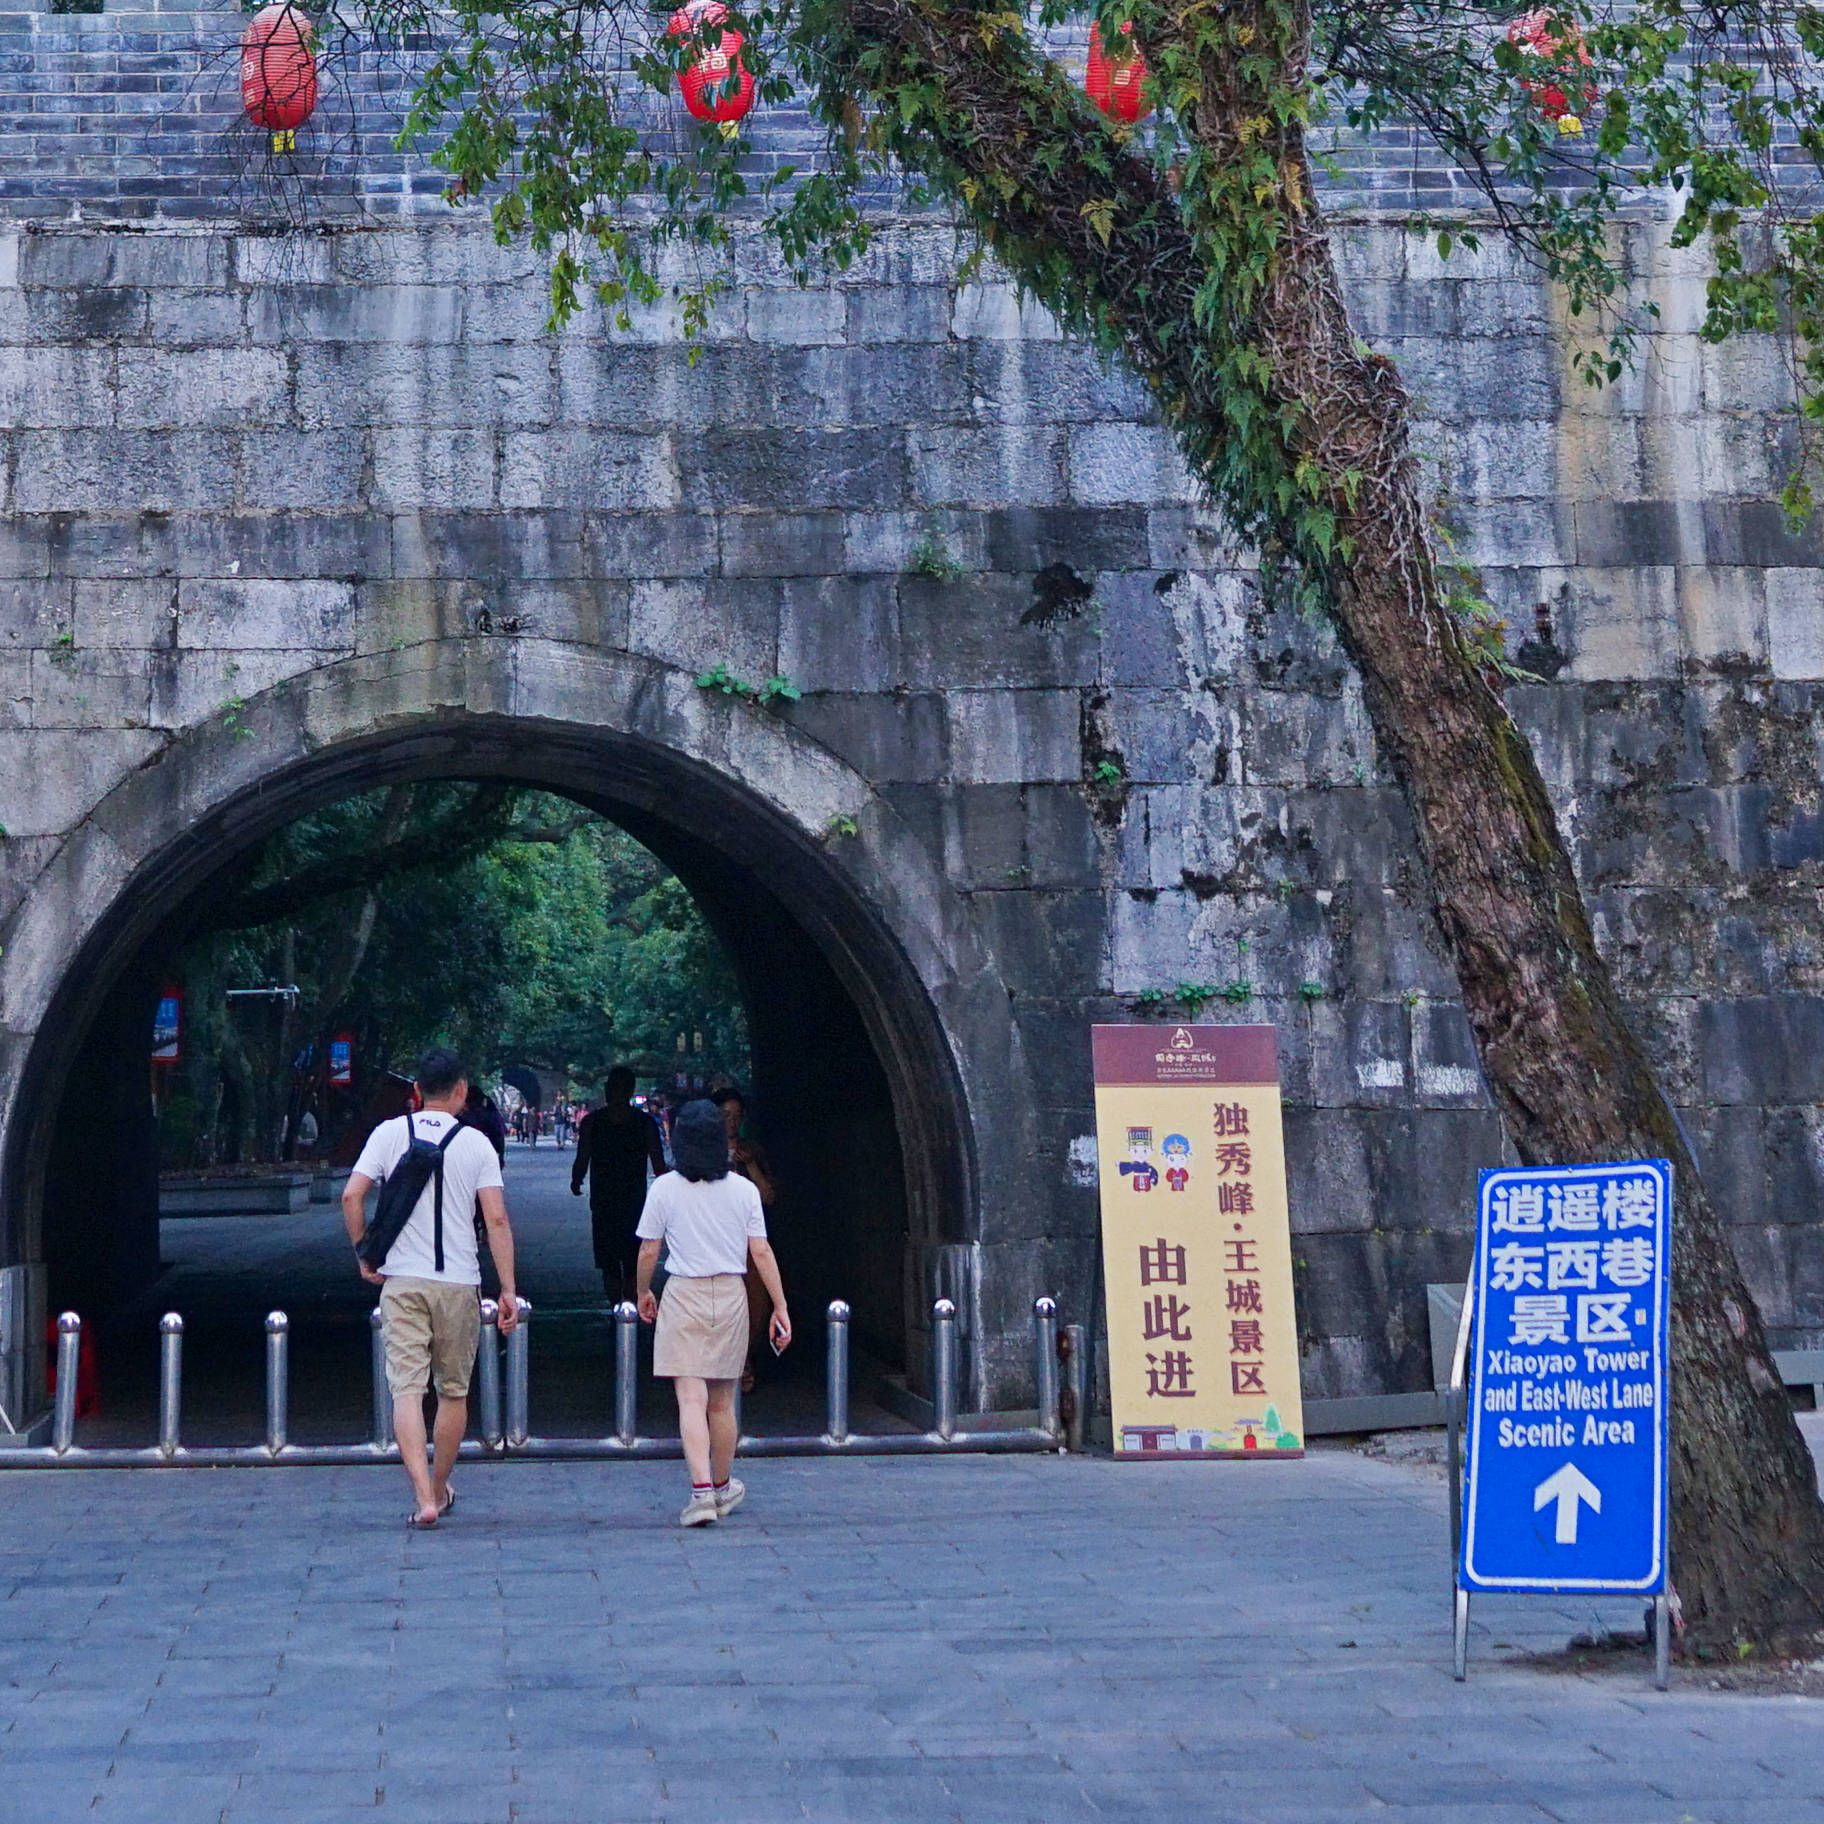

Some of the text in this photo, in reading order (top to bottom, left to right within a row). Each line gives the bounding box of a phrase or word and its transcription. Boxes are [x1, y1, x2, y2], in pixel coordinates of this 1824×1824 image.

[1491, 1178, 1656, 1234] 逍遥楼
[1212, 1101, 1268, 1398] 独秀峰·王城景区
[1488, 1236, 1655, 1291] 东西巷
[1138, 1237, 1197, 1398] 由此进
[1507, 1292, 1632, 1346] 景区
[1487, 1347, 1650, 1380] Xiaoyao Tower
[1484, 1377, 1655, 1412] and East-West Lane
[1498, 1413, 1636, 1448] Scenic Area
